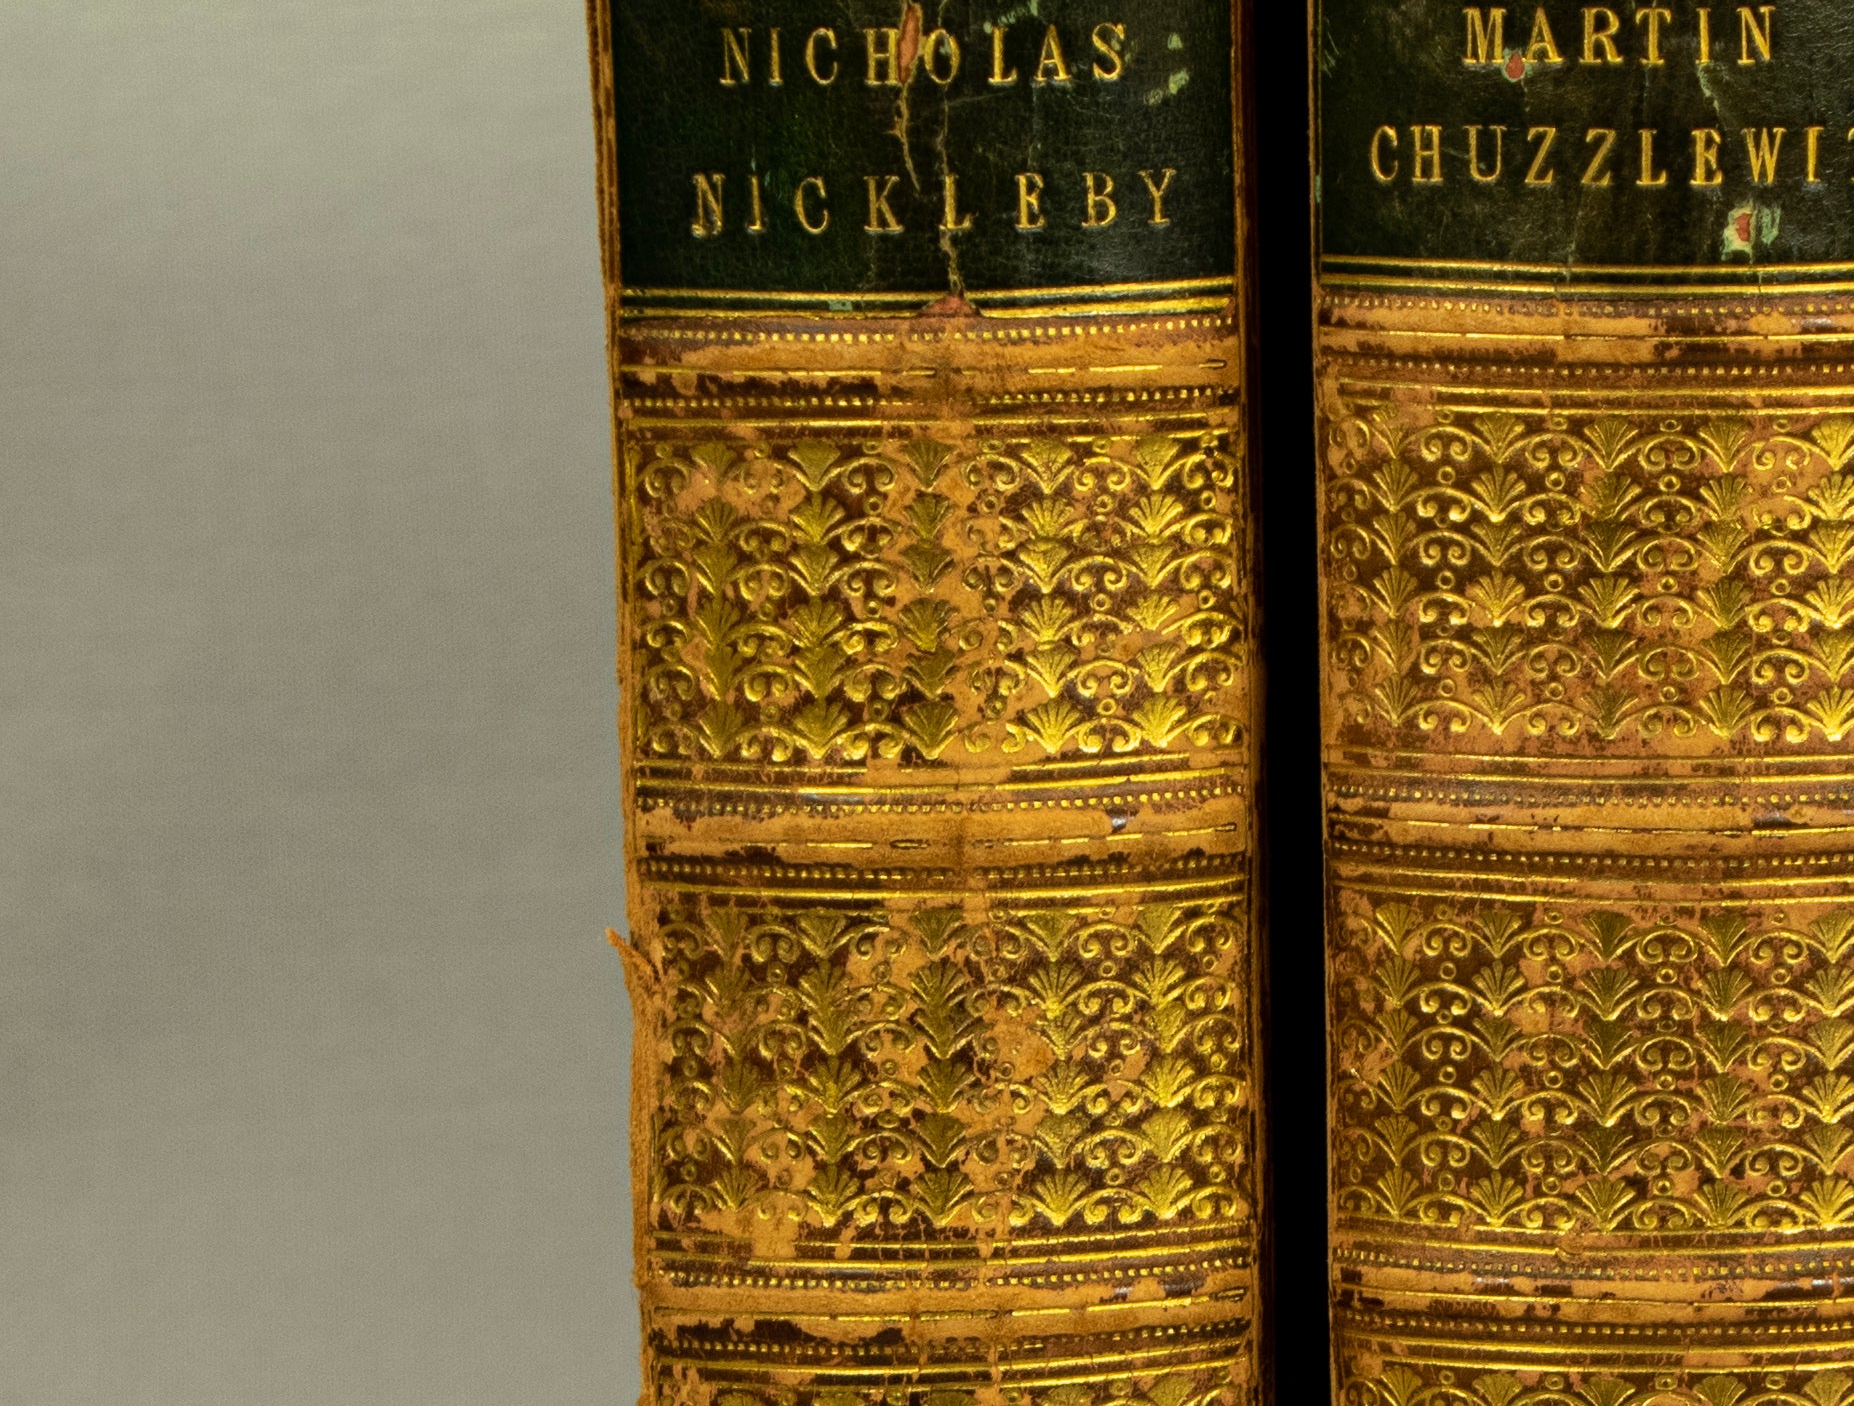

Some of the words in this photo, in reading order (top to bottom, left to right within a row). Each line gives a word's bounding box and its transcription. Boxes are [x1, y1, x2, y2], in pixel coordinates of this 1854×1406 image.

[718, 22, 1127, 86] NICHOLAS
[1461, 4, 1777, 66] MARTIN
[691, 167, 1178, 238] NICKLEBY
